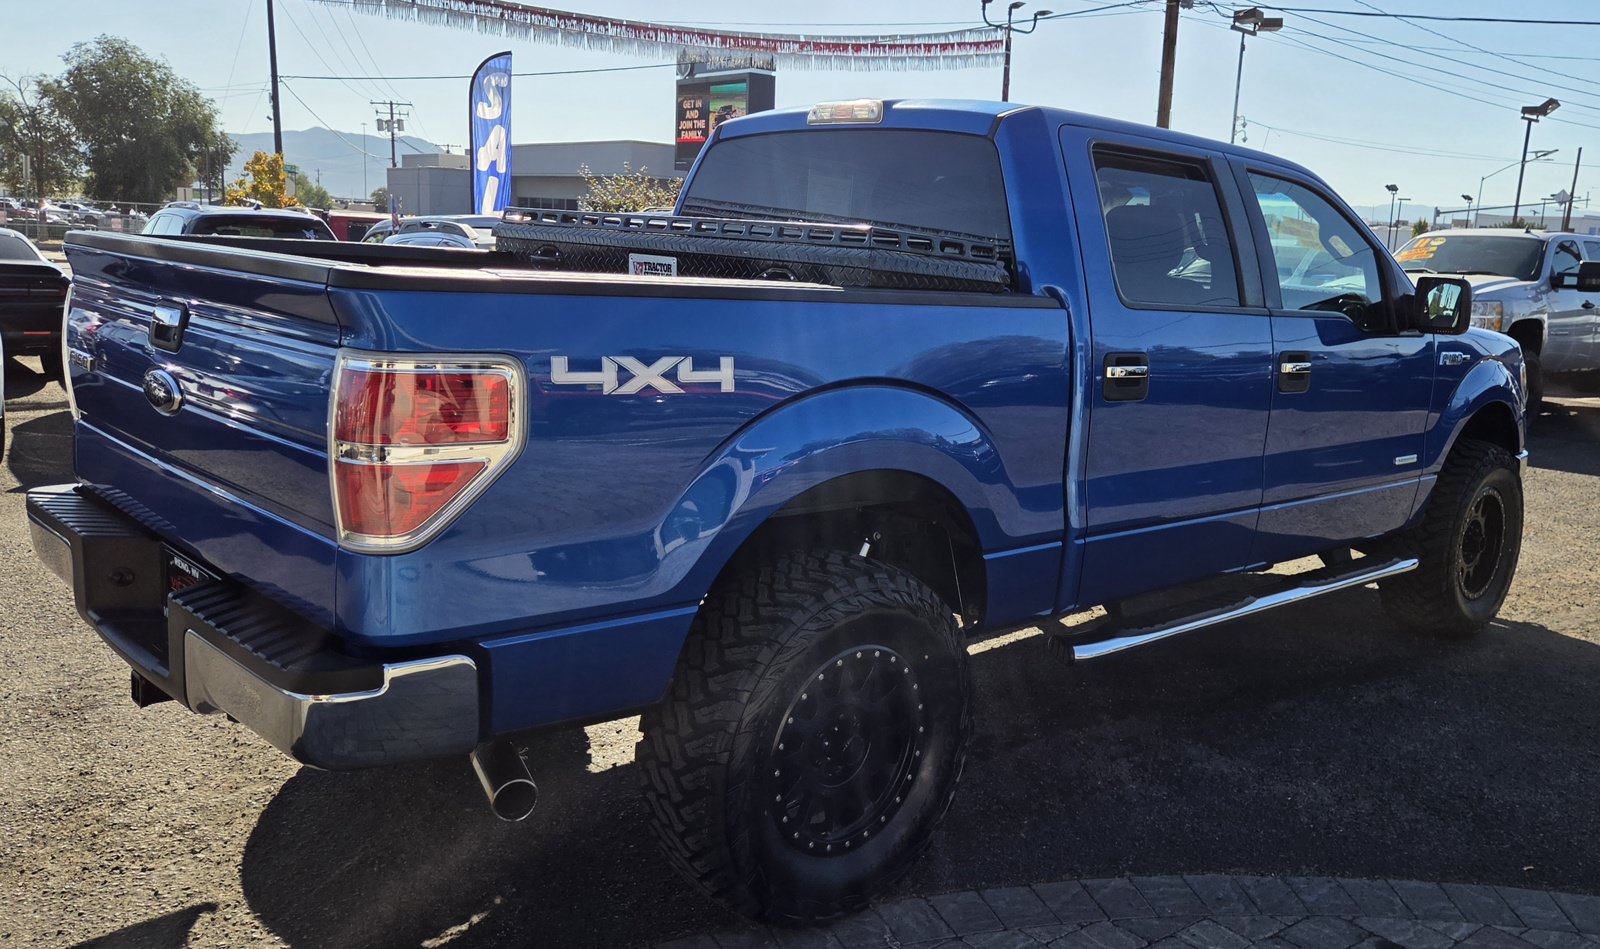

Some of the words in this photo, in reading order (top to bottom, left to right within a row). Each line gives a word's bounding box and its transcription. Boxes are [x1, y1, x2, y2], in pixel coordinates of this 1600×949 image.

[682, 99, 695, 109] GET
[695, 99, 703, 108] IN
[685, 109, 699, 119] AND
[678, 120, 693, 130] JOIN
[693, 119, 706, 129] THE
[643, 261, 672, 273] TRACTOR
[173, 556, 191, 575] RENO,
[191, 567, 200, 579] NV
